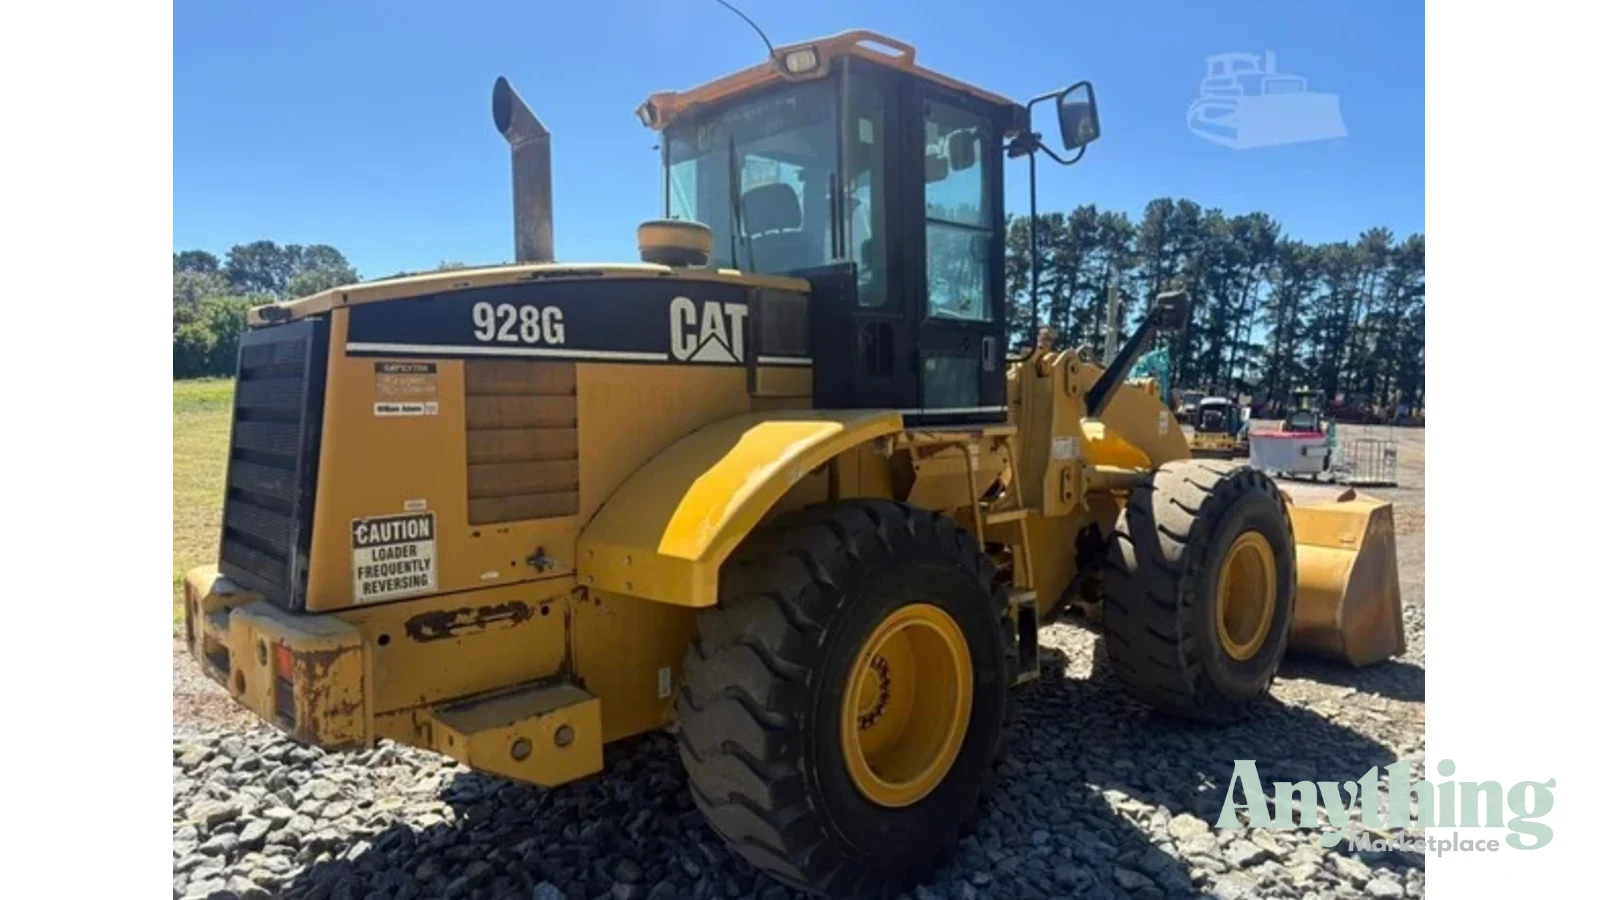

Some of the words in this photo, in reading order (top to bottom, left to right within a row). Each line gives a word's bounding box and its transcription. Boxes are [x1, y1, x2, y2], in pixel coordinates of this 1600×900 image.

[472, 301, 565, 345] 928G
[670, 296, 749, 363] CAT
[356, 518, 429, 544] CAUTION
[371, 545, 417, 561] LOADER
[357, 558, 431, 580] FREQUENTLY
[362, 573, 429, 595] REVERSING
